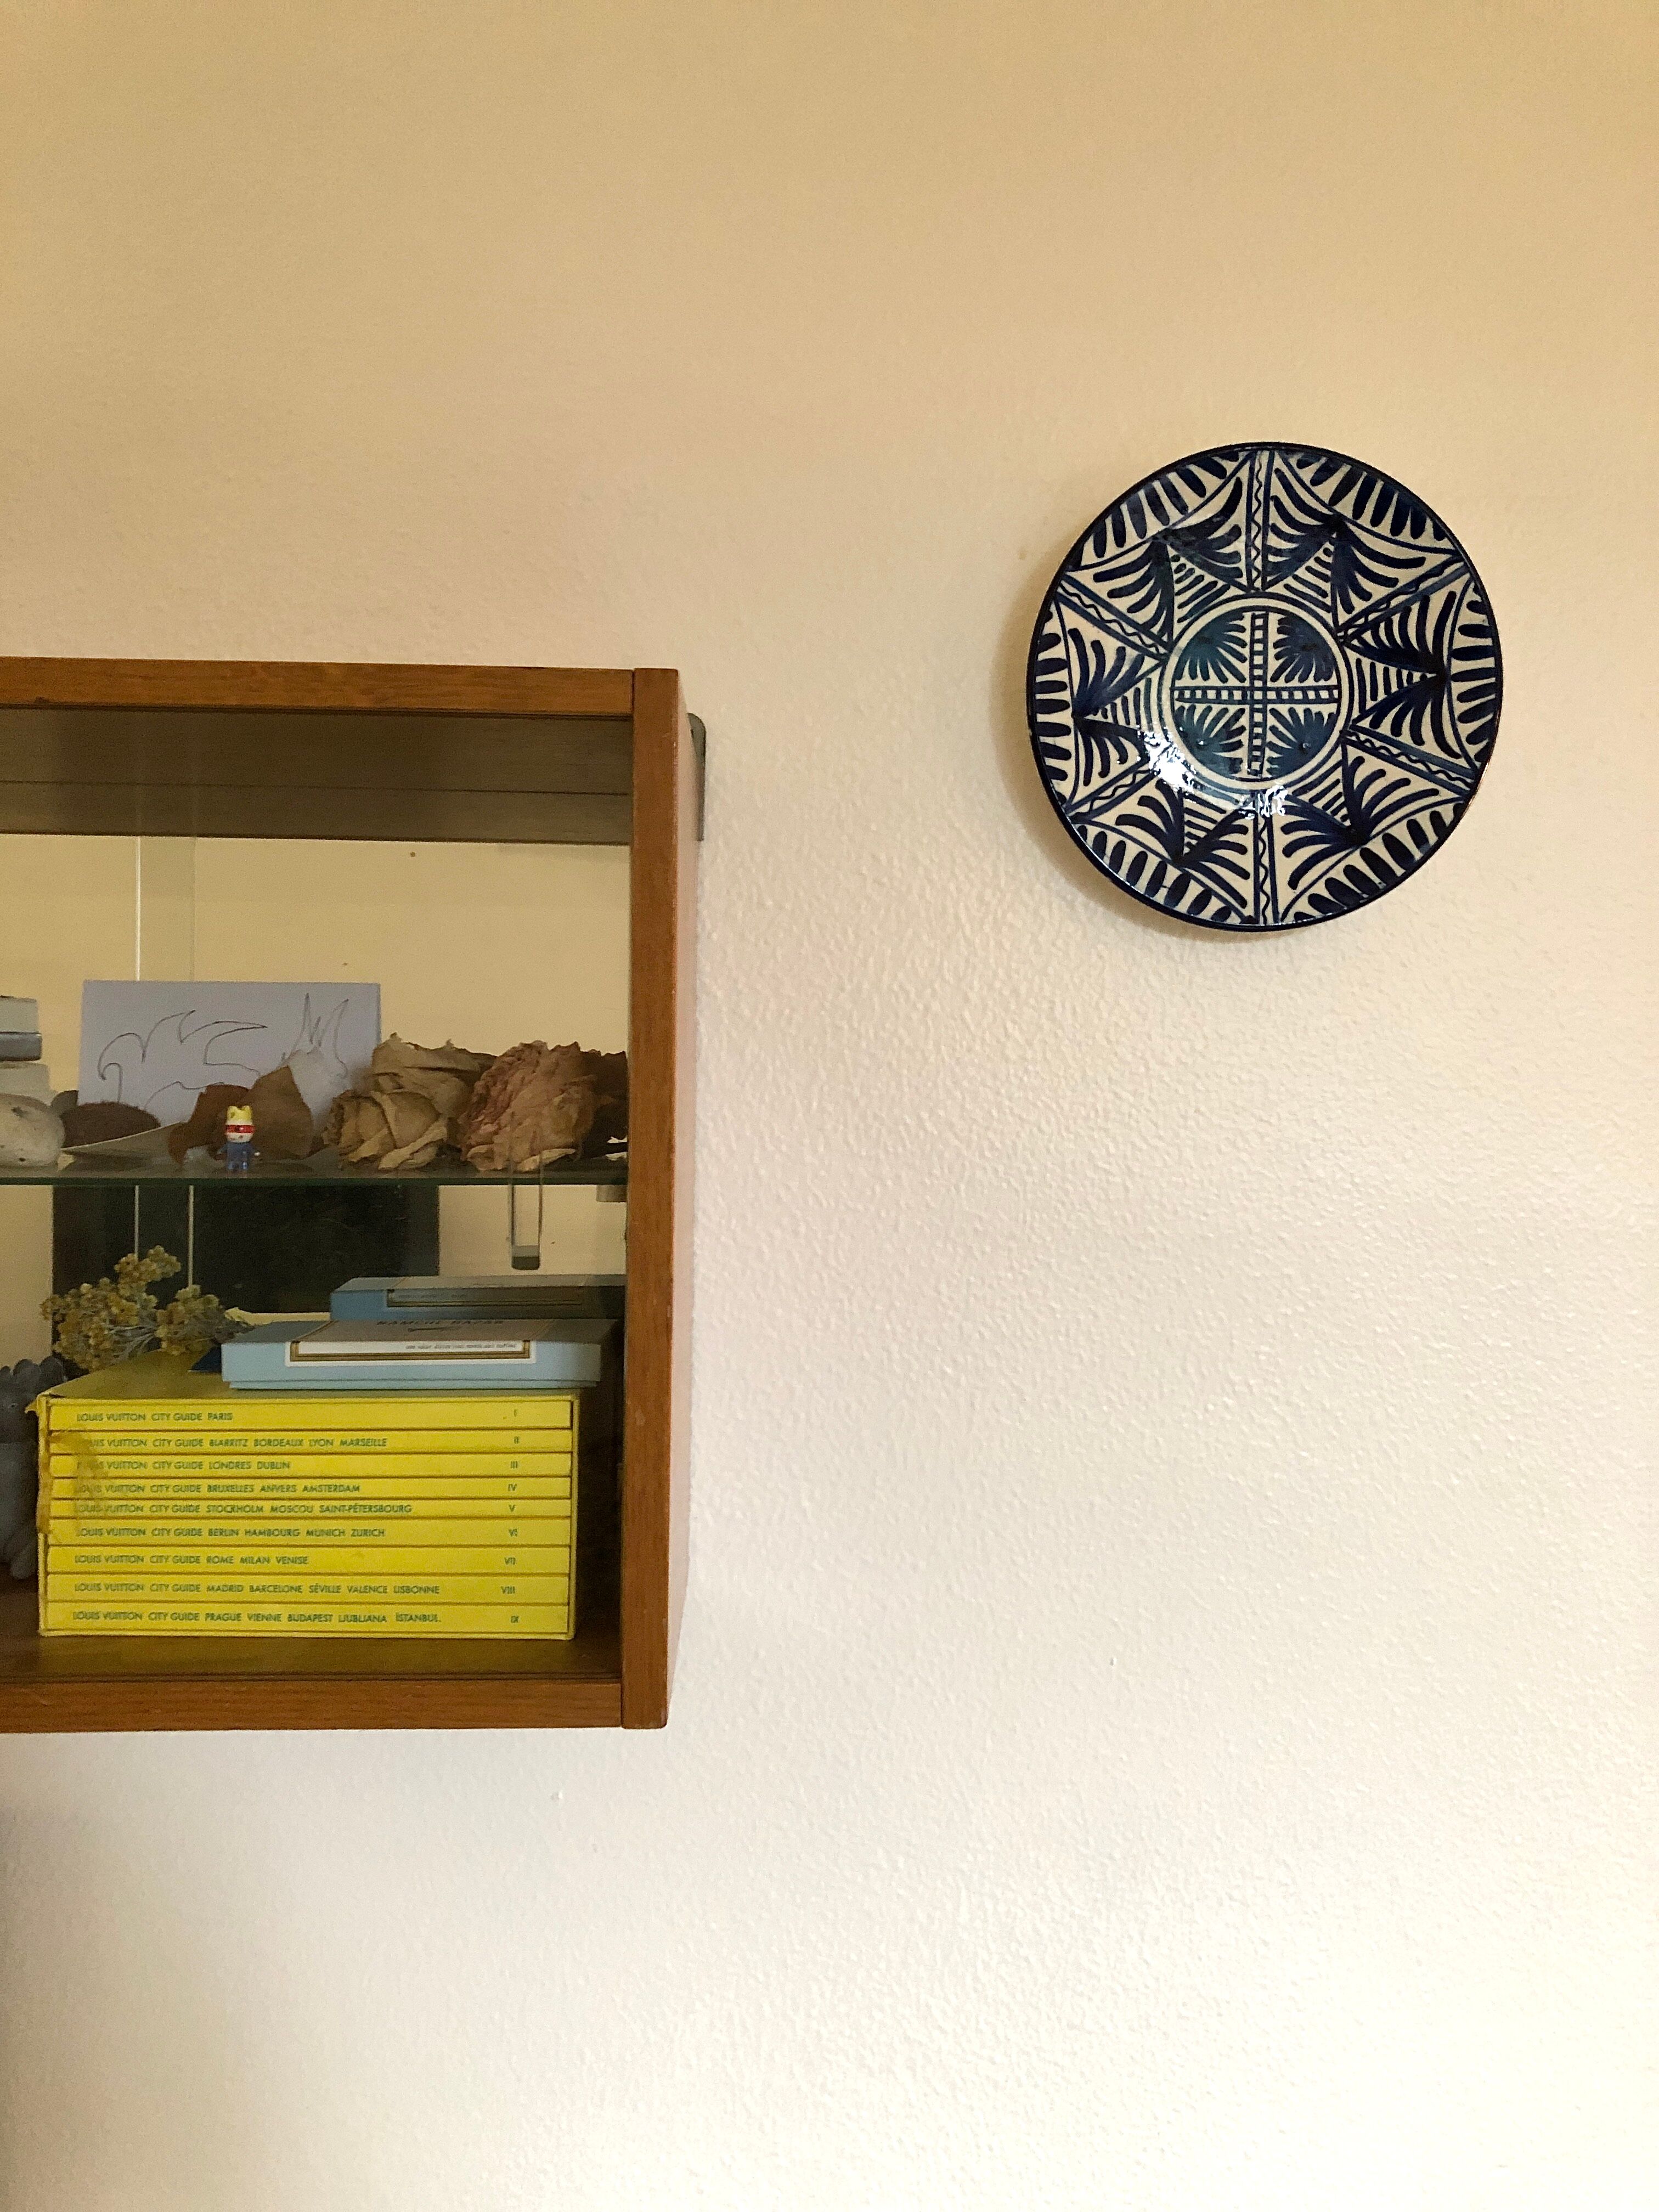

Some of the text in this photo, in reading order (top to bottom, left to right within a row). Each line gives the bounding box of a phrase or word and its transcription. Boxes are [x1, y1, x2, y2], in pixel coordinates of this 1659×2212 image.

[106, 1413, 145, 1421] VUITTON
[151, 1413, 171, 1421] CITY
[173, 1413, 202, 1421] GUIDE
[207, 1413, 233, 1421] PARIS
[108, 1461, 146, 1469] VUITTON
[153, 1461, 171, 1469] CITY
[174, 1461, 202, 1469] GUIDE
[209, 1461, 251, 1469] LONDRES
[105, 1485, 145, 1493] VUITTON
[150, 1484, 169, 1493] CITY
[173, 1485, 201, 1493] GUIDE
[207, 1485, 254, 1493] BRUXELLES
[260, 1485, 297, 1493] ANVERS
[303, 1485, 360, 1493] AMSTERDAM
[508, 1483, 517, 1492] IV
[172, 1505, 200, 1513] GUIDE
[207, 1505, 263, 1513] STOCKHOLM
[270, 1505, 313, 1513] MOSCOU
[509, 1504, 516, 1513] V
[105, 1528, 145, 1536] VUITTON
[151, 1528, 171, 1536] CITY
[174, 1528, 202, 1536] GUIDE
[208, 1528, 239, 1536] BERLIN
[245, 1528, 301, 1537] HAMBOURG
[306, 1528, 345, 1537] MUNICH
[75, 1555, 101, 1564] LOUIS
[105, 1555, 144, 1564] VUITTON
[149, 1555, 168, 1564] CITY
[172, 1555, 201, 1564] GUIDE
[240, 1556, 270, 1564] MILAN
[275, 1556, 308, 1564] VENISE
[504, 1557, 516, 1565] VII
[75, 1583, 101, 1592] LOUIS
[104, 1583, 144, 1592] VUITTON
[150, 1583, 169, 1592] CITY
[249, 1585, 303, 1593] BARCELONE
[347, 1585, 388, 1594] VALENCE
[393, 1585, 440, 1594] LISBONNE
[501, 1585, 515, 1594] VIII
[72, 1611, 100, 1620] LOUIS
[103, 1611, 142, 1620] VUITTON
[148, 1612, 167, 1620] CITY
[170, 1612, 200, 1621] GUIDE
[205, 1612, 242, 1621] PRAGUE
[247, 1613, 281, 1622] VIENNE
[287, 1613, 332, 1622] BUDAPEST
[338, 1614, 387, 1622] LJUBLJANA
